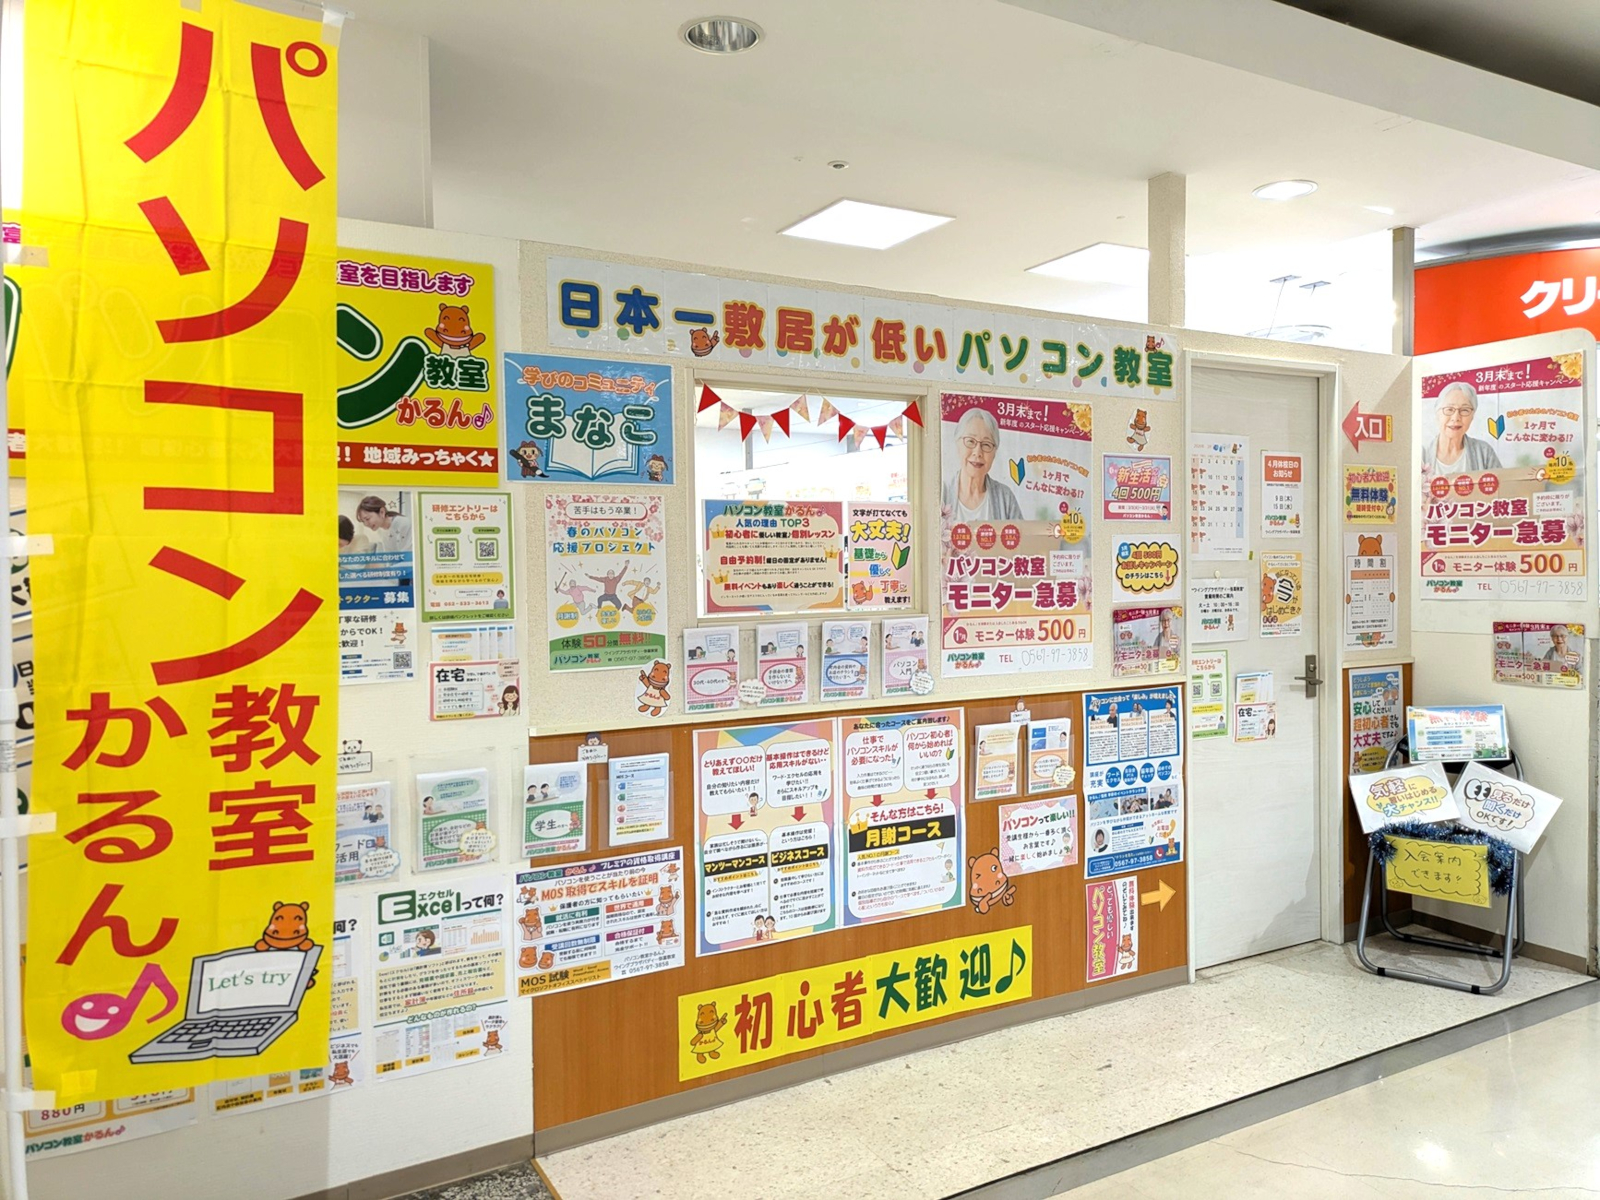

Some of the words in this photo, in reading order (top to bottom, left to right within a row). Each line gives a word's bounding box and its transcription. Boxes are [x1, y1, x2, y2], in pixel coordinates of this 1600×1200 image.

[337, 260, 474, 297] 室を目指します
[1519, 276, 1600, 319] クリ
[521, 365, 658, 397] 学びのコミュニティ
[1475, 363, 1531, 384] 3月末まで！
[1478, 382, 1497, 392] 新年度
[396, 395, 471, 429] かるん
[996, 401, 1049, 422] 3月末まで！
[525, 392, 658, 450] まなこ
[999, 418, 1018, 428] 新年度
[1354, 416, 1383, 439] 入口
[1117, 466, 1152, 485] 新生活
[1273, 470, 1293, 478] お知らせ
[445, 513, 486, 521] こちらから
[573, 505, 638, 516] 苦手はもう卒業！
[852, 508, 908, 518] 文字が打てなくても
[1427, 498, 1528, 520] パソコン教室
[735, 518, 778, 528] 人気の理由
[781, 518, 810, 528] TOP3
[566, 526, 644, 538] 春のパソコン
[1426, 519, 1567, 548] モニター急募
[552, 541, 656, 555] 応援プロジェクト
[853, 547, 889, 561] 基礎から
[868, 563, 891, 577] 優しく
[947, 556, 1046, 577] パソコン教室
[1452, 561, 1517, 573] モニター体験
[1124, 572, 1164, 580] のチラシはこちら
[1477, 582, 1493, 591] TEL
[1498, 579, 1584, 596] 0567-97-3858
[383, 591, 410, 604] 募集
[947, 581, 1078, 612] モニター急募
[974, 627, 1036, 643] モニター体験
[893, 660, 918, 668] パソコン
[999, 654, 1013, 663] TEL
[1021, 647, 1090, 667] 0567-97-3858
[436, 668, 465, 683] 在宅
[899, 668, 913, 676] 入門
[1238, 708, 1253, 718] 在宅
[1353, 701, 1372, 717] 安心
[1353, 714, 1390, 732] 超初心者
[1389, 714, 1399, 722] さん
[1389, 721, 1400, 729] でも
[862, 735, 884, 745] 仕事で
[907, 739, 953, 751] 何から始めれば
[1353, 732, 1382, 749] 大丈夫
[847, 743, 899, 756] パソコンスキルが
[1368, 777, 1407, 801] 気軽
[1489, 787, 1531, 809] 見るだけ
[1482, 799, 1523, 819] 聞くだけ
[865, 821, 942, 848] 月謝コース
[771, 846, 825, 864] ビジネスコース
[1404, 848, 1462, 867] 入会案内
[705, 855, 766, 873] マンツーマンコース
[418, 889, 454, 901] エクセル
[559, 890, 644, 910] 保護者の方に知ってもらいたい
[1092, 885, 1106, 977] パソコン教室
[208, 972, 256, 991] Let's
[262, 971, 291, 994] try
[520, 975, 546, 988] MOS
[548, 969, 570, 983] 試験
